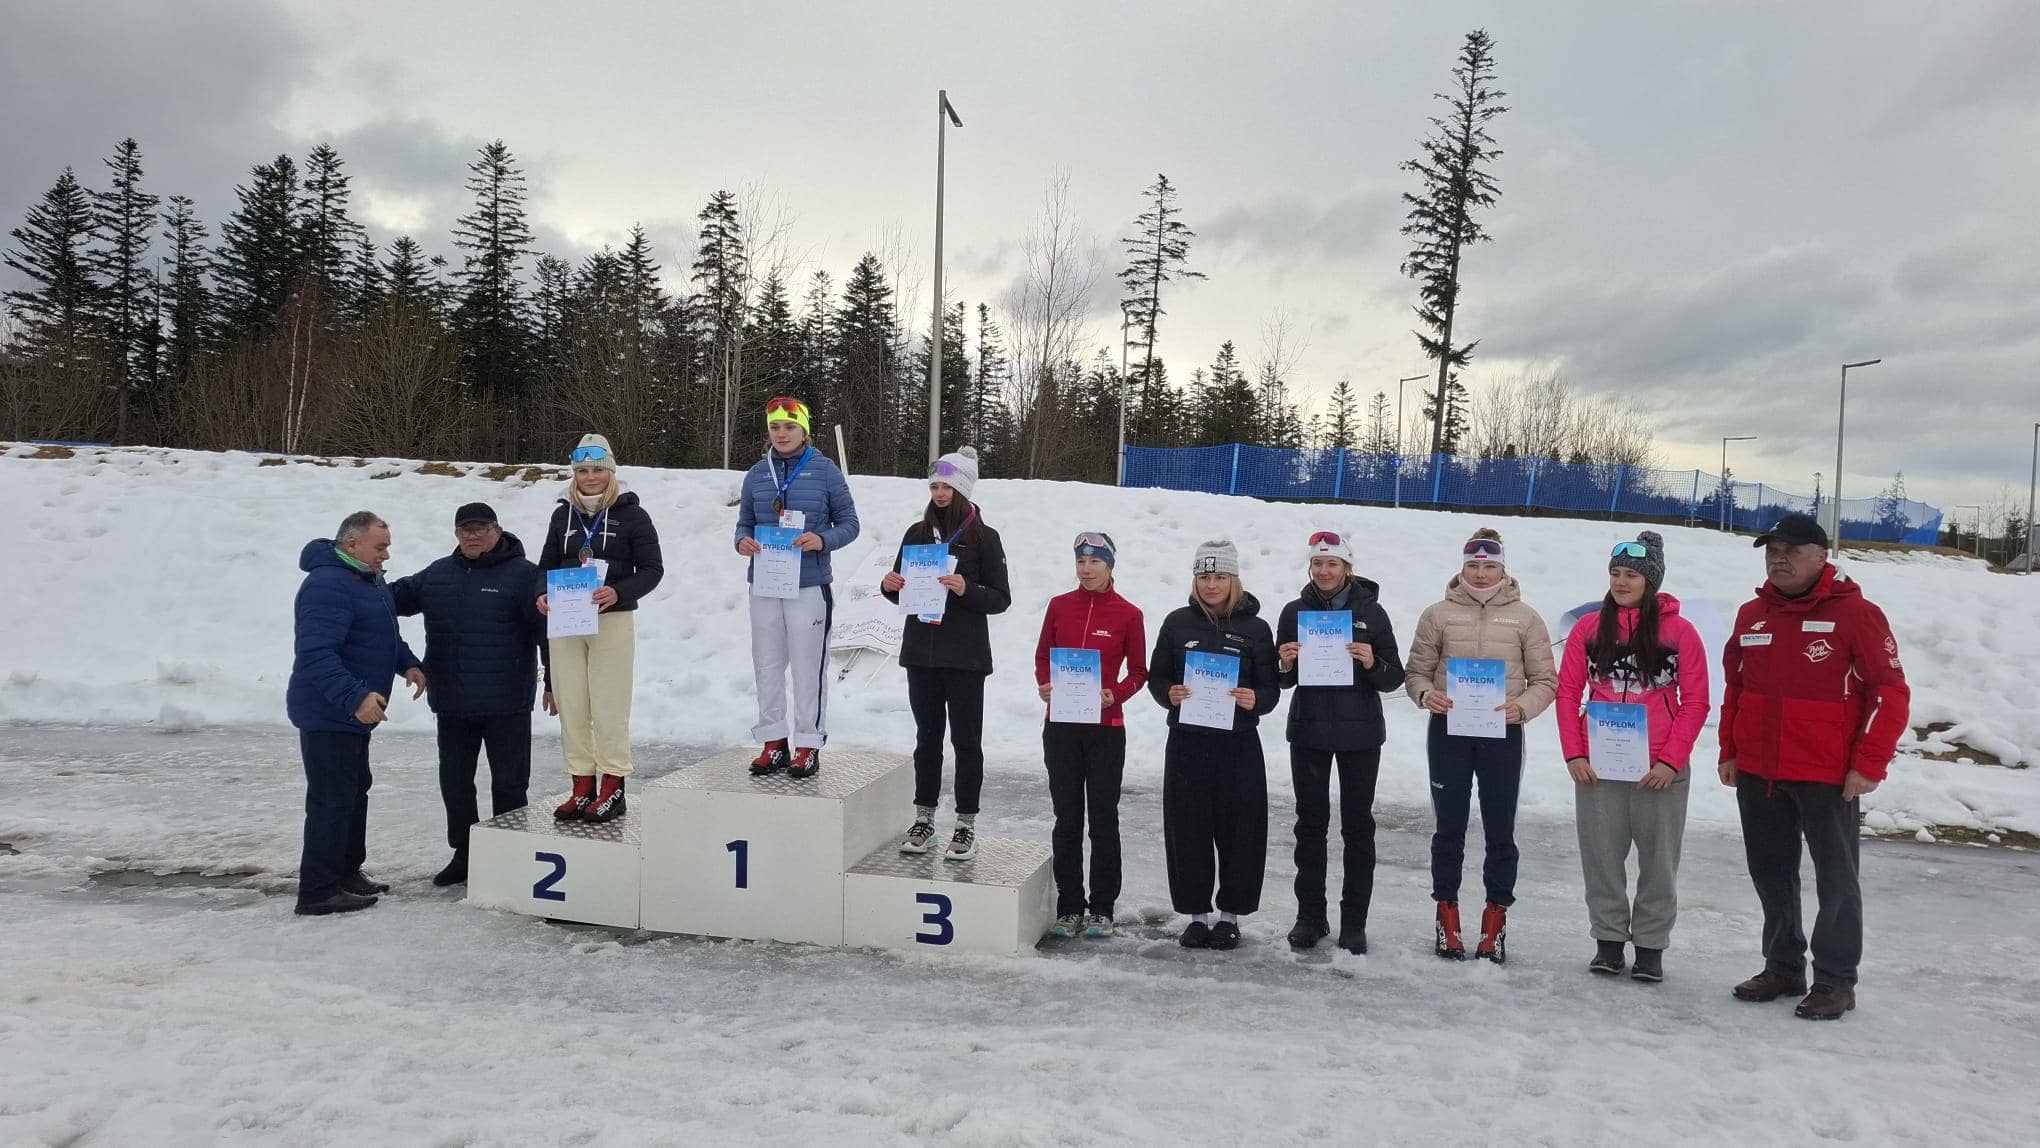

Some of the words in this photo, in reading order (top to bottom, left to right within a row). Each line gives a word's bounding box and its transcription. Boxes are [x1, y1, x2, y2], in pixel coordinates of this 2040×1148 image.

[762, 543, 793, 551] DYPLOM
[910, 559, 939, 568] DYPLOM
[556, 582, 588, 592] DYPLOM
[1308, 627, 1343, 636] DYPLOM
[1060, 665, 1092, 673] DYPLOM
[1195, 667, 1228, 680] DYPLOM
[1458, 676, 1495, 685] DYPLOM
[1598, 719, 1636, 729] DYPLOM
[596, 788, 623, 817] alpina
[726, 840, 748, 889] 1
[533, 851, 567, 902] 2
[914, 892, 955, 946] 3
